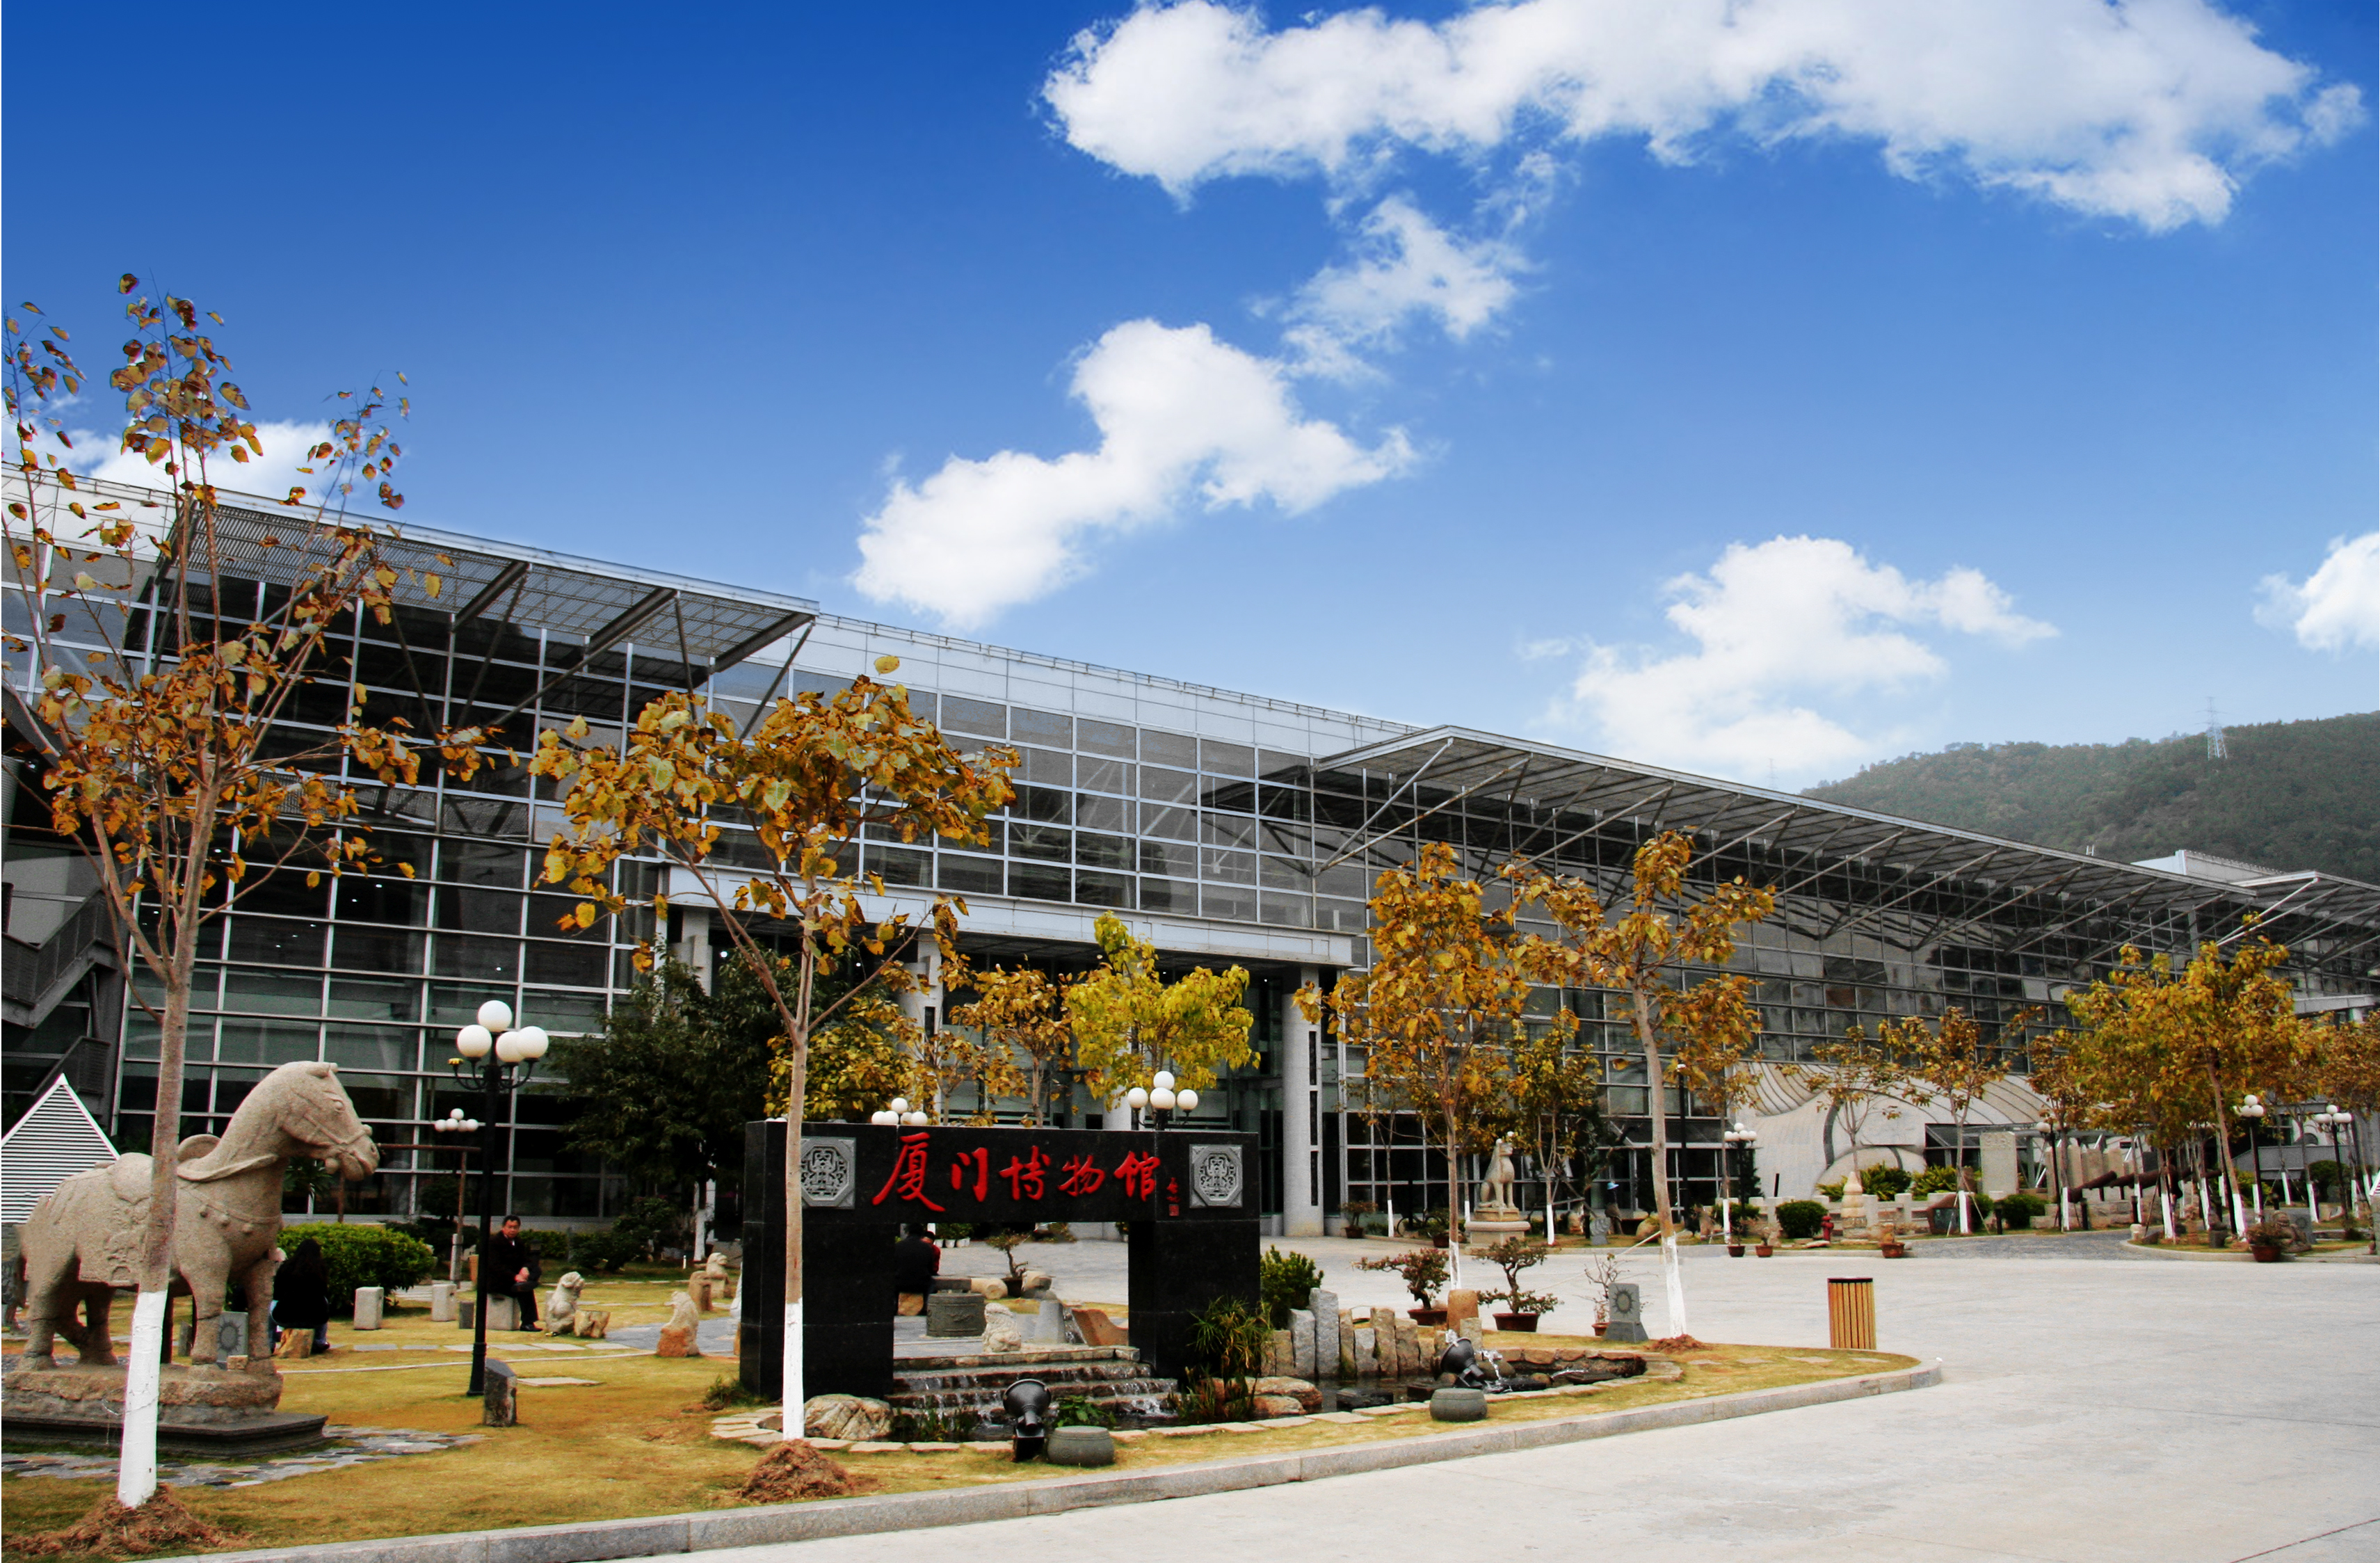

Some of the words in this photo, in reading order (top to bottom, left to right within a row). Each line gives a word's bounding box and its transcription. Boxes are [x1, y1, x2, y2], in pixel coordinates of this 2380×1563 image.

[872, 1132, 1161, 1212] 厦门博物馆
